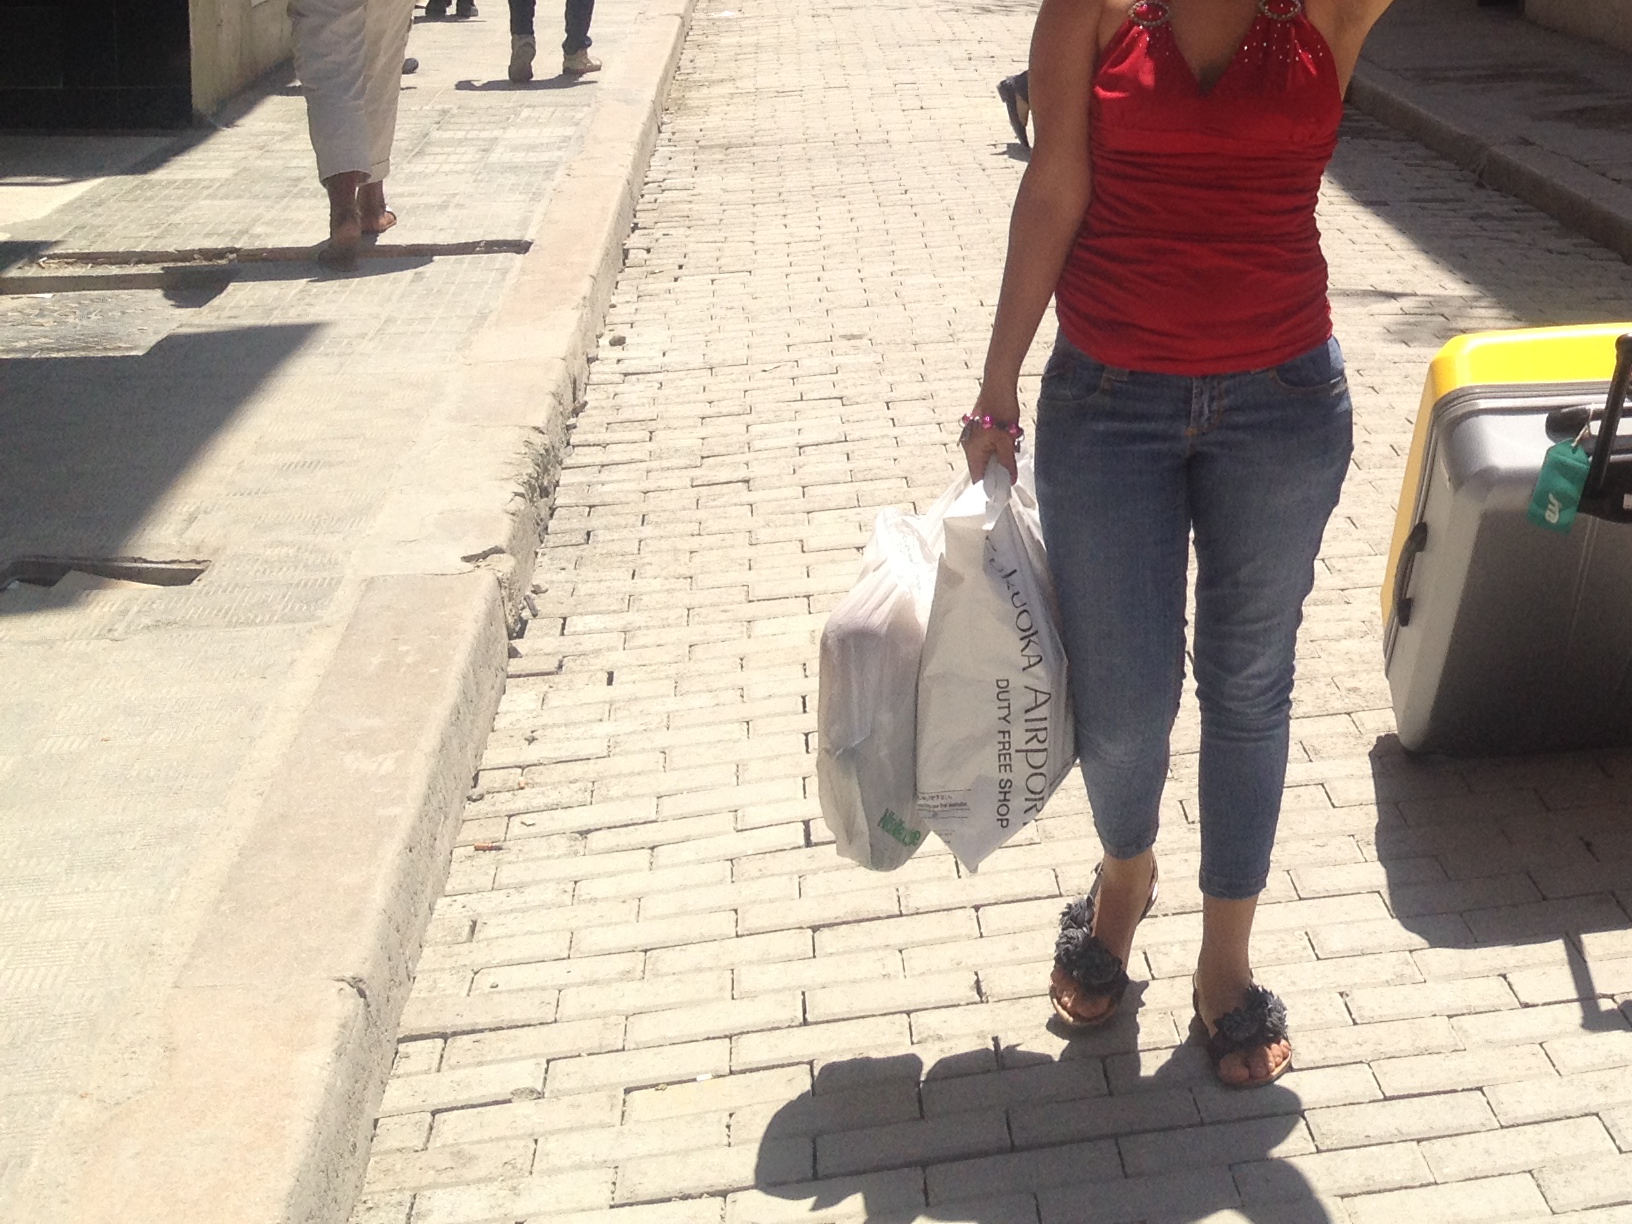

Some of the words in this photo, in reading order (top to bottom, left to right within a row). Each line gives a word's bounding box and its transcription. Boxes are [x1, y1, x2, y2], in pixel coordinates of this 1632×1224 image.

[996, 678, 1011, 724] DUTY
[998, 729, 1012, 773] FREE
[1015, 684, 1052, 825] AIRPOR
[996, 779, 1012, 829] SHOP
